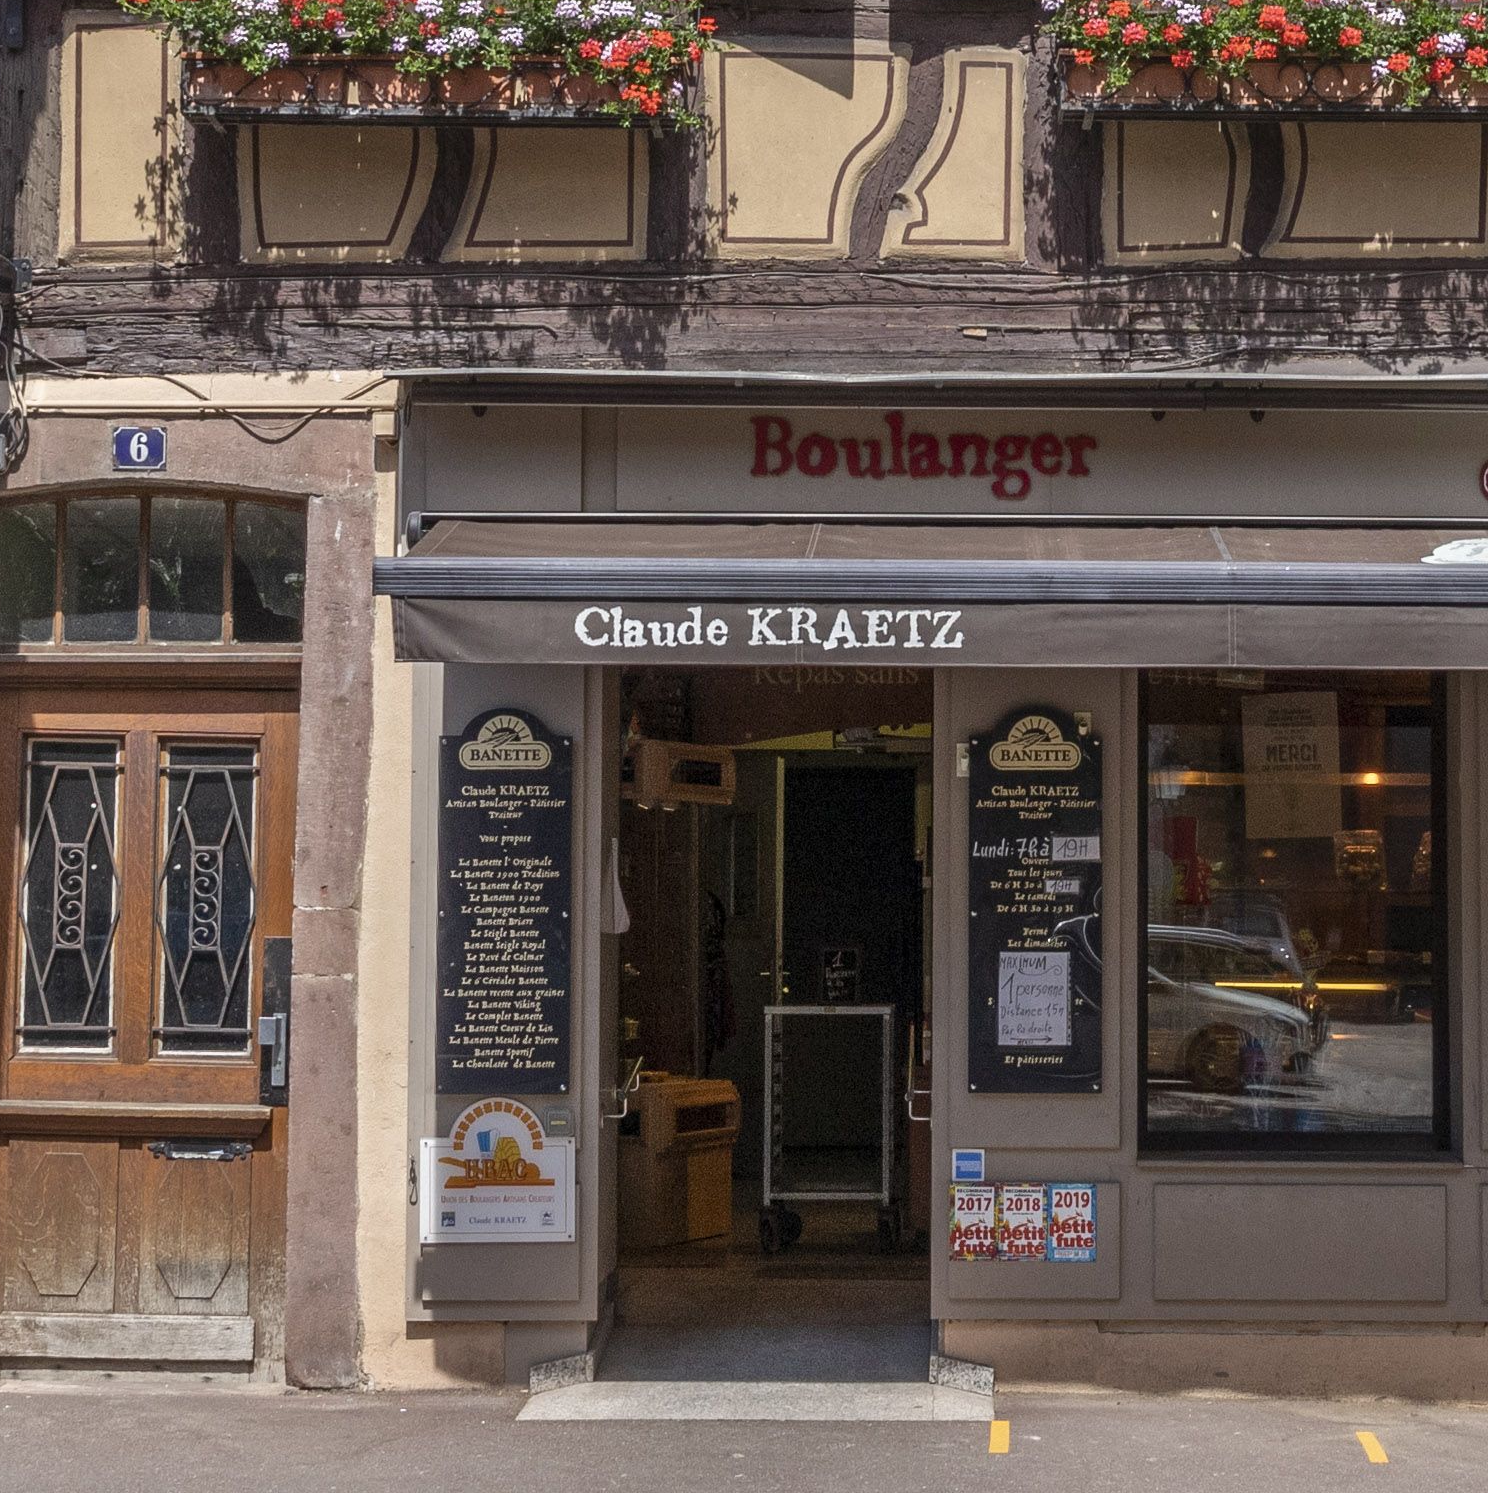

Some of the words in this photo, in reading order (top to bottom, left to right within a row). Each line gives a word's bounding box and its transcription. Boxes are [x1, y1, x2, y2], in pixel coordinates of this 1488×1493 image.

[129, 432, 149, 463] 6
[750, 412, 1097, 500] Boulanger
[574, 606, 728, 648] Claude
[747, 607, 964, 650] KRAETZ
[752, 665, 851, 694] Repas
[470, 749, 541, 761] BANETTE
[1000, 749, 1071, 762] BANETTE
[1266, 744, 1318, 762] MERCI
[462, 786, 496, 796] Claude
[500, 786, 550, 796] KRAETZ
[992, 786, 1026, 796] Claude
[1030, 786, 1080, 796] KRAETZ
[445, 799, 477, 808] Artisan
[479, 798, 522, 810] Boulanger
[976, 799, 1007, 808] Artisan
[1010, 798, 1052, 811] Boulanger
[489, 811, 522, 819] Traiteur
[501, 835, 531, 846] propose
[972, 837, 1014, 858] Lundi:
[1057, 839, 1088, 858] 19H
[459, 858, 470, 866] La
[473, 858, 502, 866] Banette
[513, 856, 552, 869] Originale
[450, 870, 462, 878] La
[464, 870, 494, 878] Banette
[497, 871, 519, 879] 1900
[521, 869, 560, 878] Tradition
[466, 881, 477, 890] La
[480, 881, 509, 890] Banette
[470, 894, 480, 902] Le
[482, 894, 515, 902] Baneton
[519, 894, 540, 903] 1900
[1027, 892, 1056, 901] samedi
[474, 905, 517, 917] Campagne
[477, 918, 506, 926] Banette
[484, 928, 507, 940] Seigle
[464, 942, 493, 950] Banette
[496, 940, 520, 952] Seigle
[522, 939, 546, 951] Royal
[513, 952, 544, 961] Colmar
[479, 965, 508, 973] Banette
[511, 965, 544, 973] Moisson
[518, 977, 548, 985] Banette
[535, 989, 565, 1000] graines
[1016, 984, 1064, 1007] personne
[514, 1000, 541, 1011] Viking
[1000, 1004, 1043, 1018] Distance
[478, 1012, 512, 1023] Complet
[538, 1024, 554, 1032] Lin
[1028, 1021, 1052, 1033] droite
[463, 1036, 493, 1044] Banette
[495, 1036, 520, 1044] Meule
[534, 1036, 559, 1044] Pierre
[474, 1048, 504, 1056] Banette
[525, 1060, 556, 1068] Banette
[957, 1197, 992, 1212] 2017
[1006, 1197, 1041, 1212] 2018
[1054, 1191, 1089, 1208] 2019
[494, 1216, 528, 1224] KRAETZ
[1000, 1225, 1046, 1243] petit
[1049, 1219, 1095, 1237] petit
[950, 1225, 997, 1244] petit
